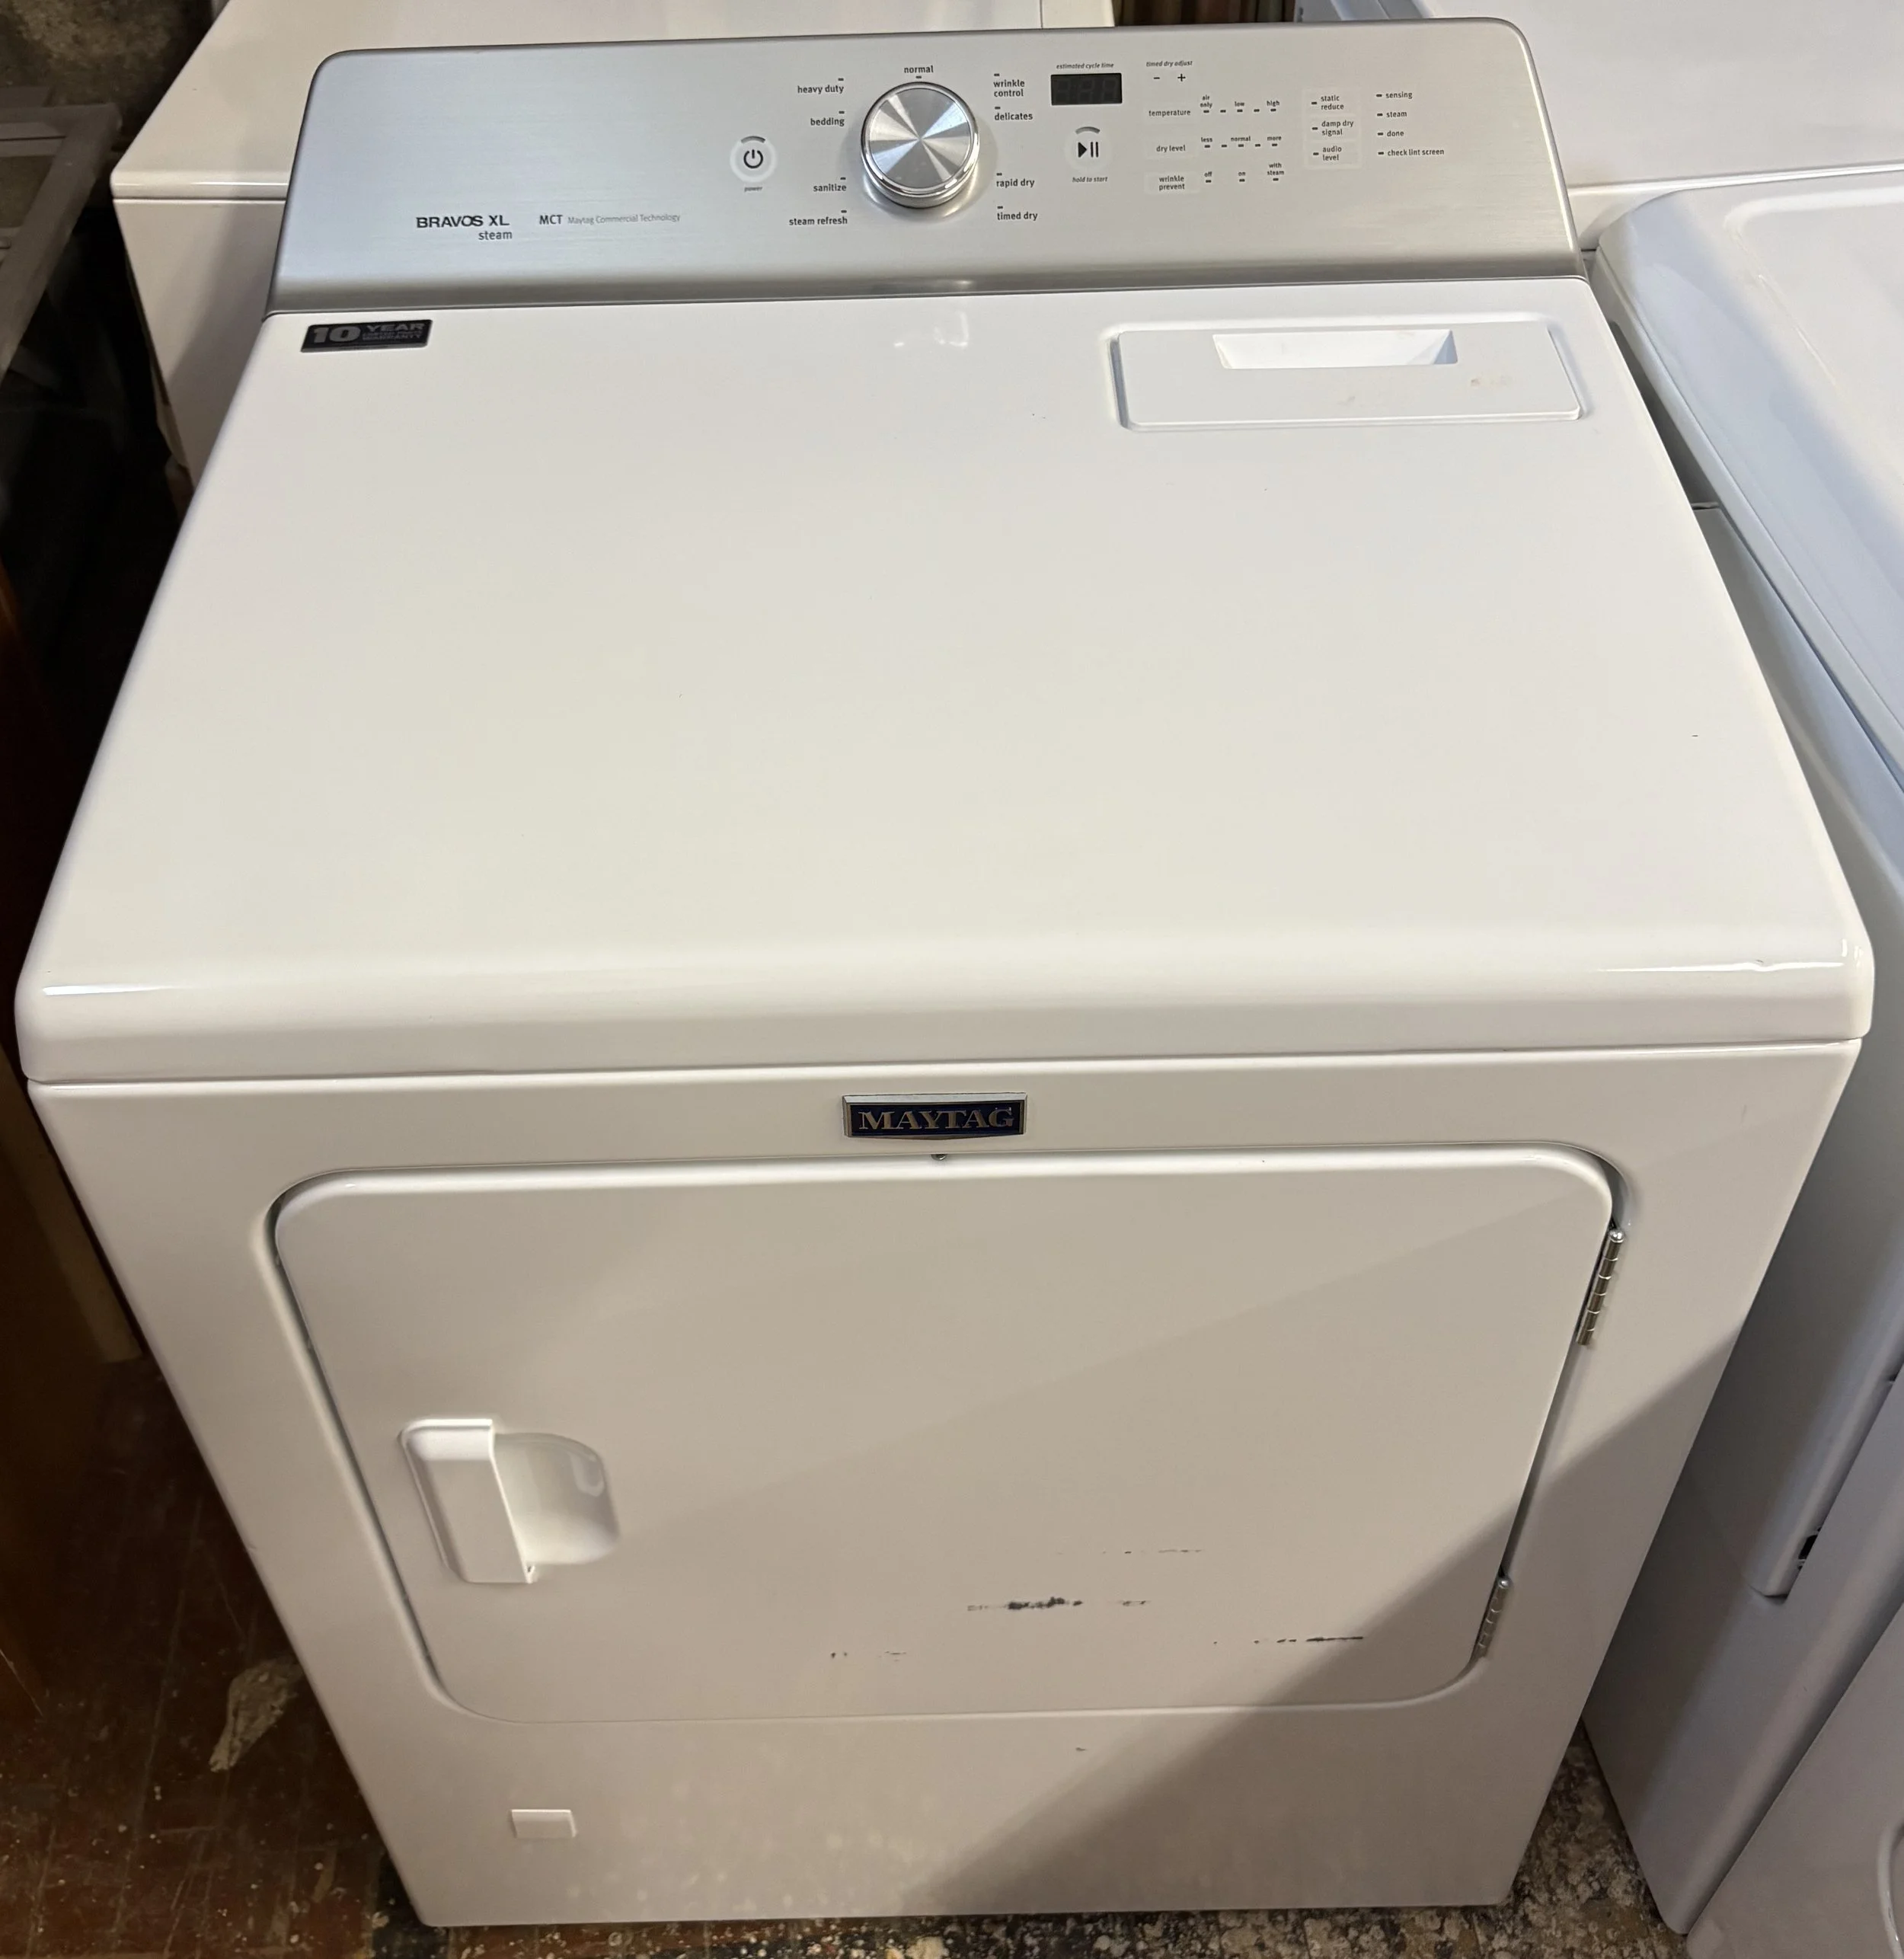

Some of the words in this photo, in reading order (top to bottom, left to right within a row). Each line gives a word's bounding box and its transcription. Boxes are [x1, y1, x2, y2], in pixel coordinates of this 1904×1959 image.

[904, 65, 934, 73] normal
[994, 79, 1024, 88] wrinkle
[797, 85, 823, 94] heavy
[825, 85, 844, 94] duty
[810, 118, 845, 126] bedding
[996, 178, 1017, 188] rapid
[1021, 178, 1035, 187] dry
[417, 216, 483, 228] BRAVOS
[488, 215, 510, 226] XL
[539, 215, 563, 225] MCT
[567, 216, 594, 225] Maytag
[596, 214, 638, 223] Commercial
[640, 214, 680, 223] Technology
[817, 216, 848, 225] refresh
[1024, 212, 1038, 221] dry
[478, 230, 513, 241] steam
[314, 326, 361, 343] 10
[367, 323, 425, 331] YEAR
[858, 1107, 1014, 1130] MAYTAG
